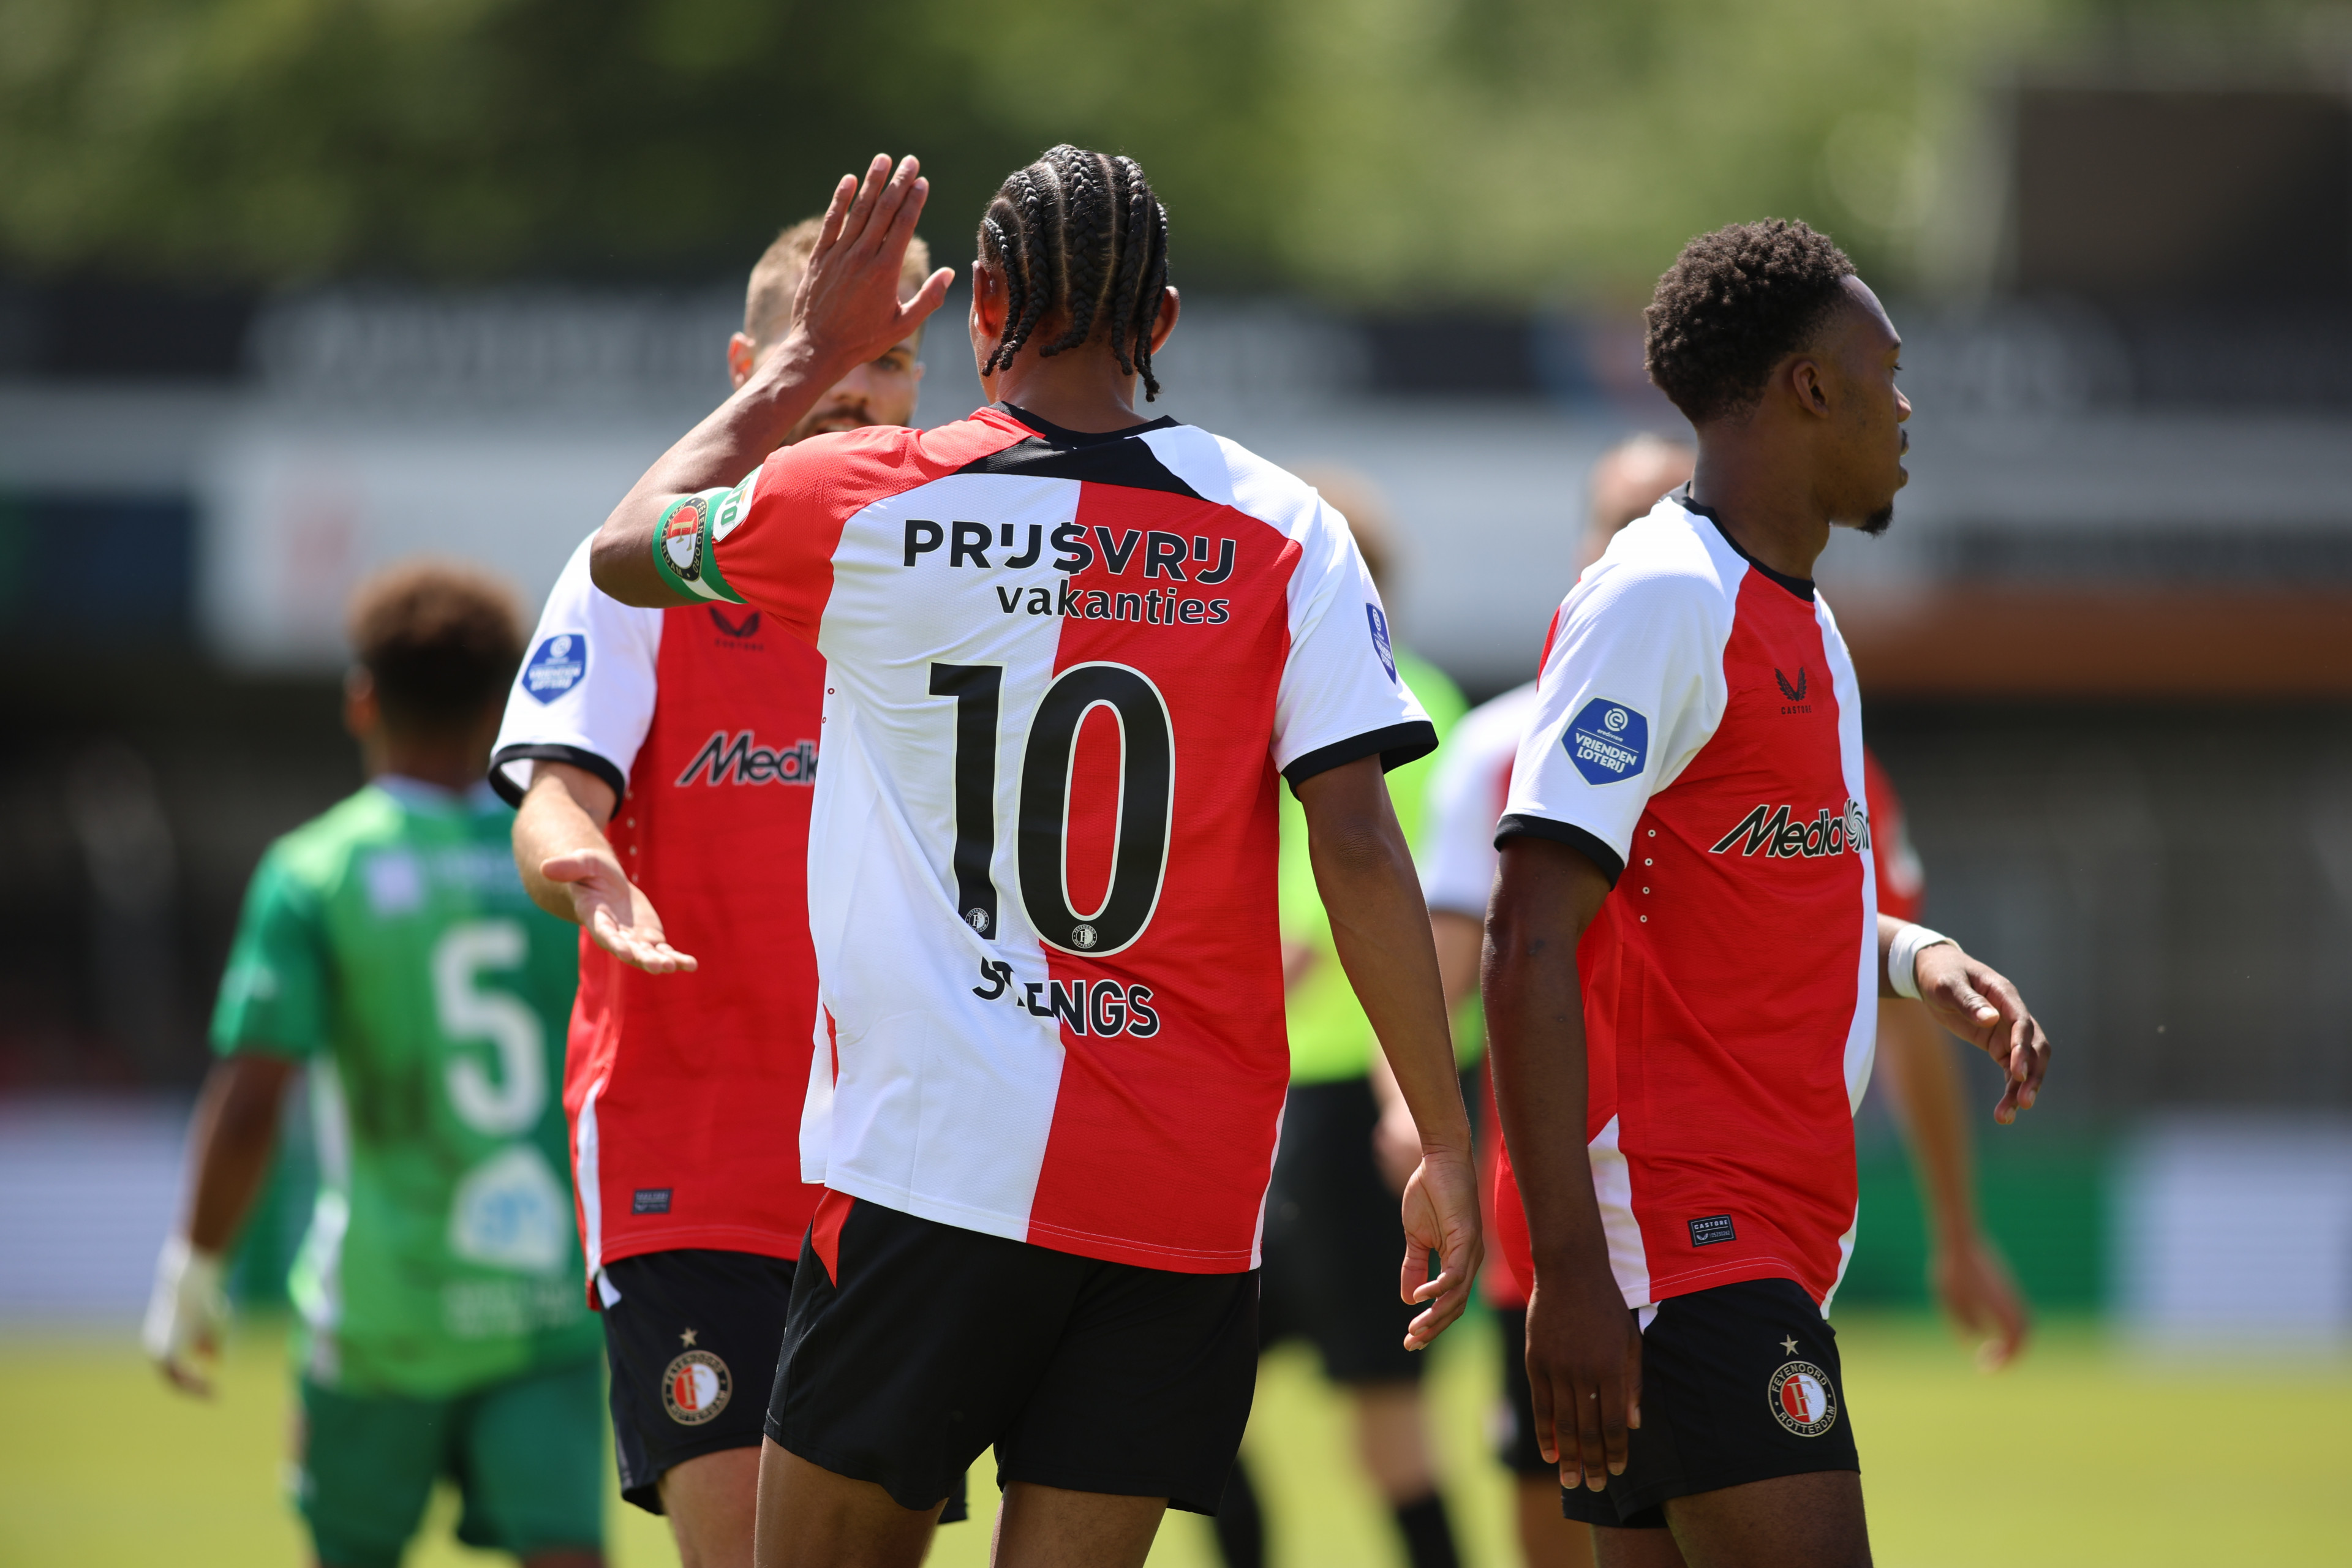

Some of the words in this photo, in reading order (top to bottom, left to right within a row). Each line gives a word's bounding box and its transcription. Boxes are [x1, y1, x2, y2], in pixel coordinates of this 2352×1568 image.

[720, 469, 757, 526] OTO
[693, 501, 707, 574] FEYENOORD
[996, 579, 1230, 625] vakanties
[1781, 705, 1812, 715] CASTORE
[674, 729, 820, 787] Medi
[1575, 733, 1637, 766] VRIENDEN
[1577, 746, 1626, 773] LOTERIJ
[925, 657, 1176, 958] 10
[431, 919, 548, 1137] 5
[1694, 1219, 1728, 1230] CASTORE
[1772, 1364, 1827, 1393] FEYENOORD
[1778, 1404, 1835, 1434] ROTTERDAM
